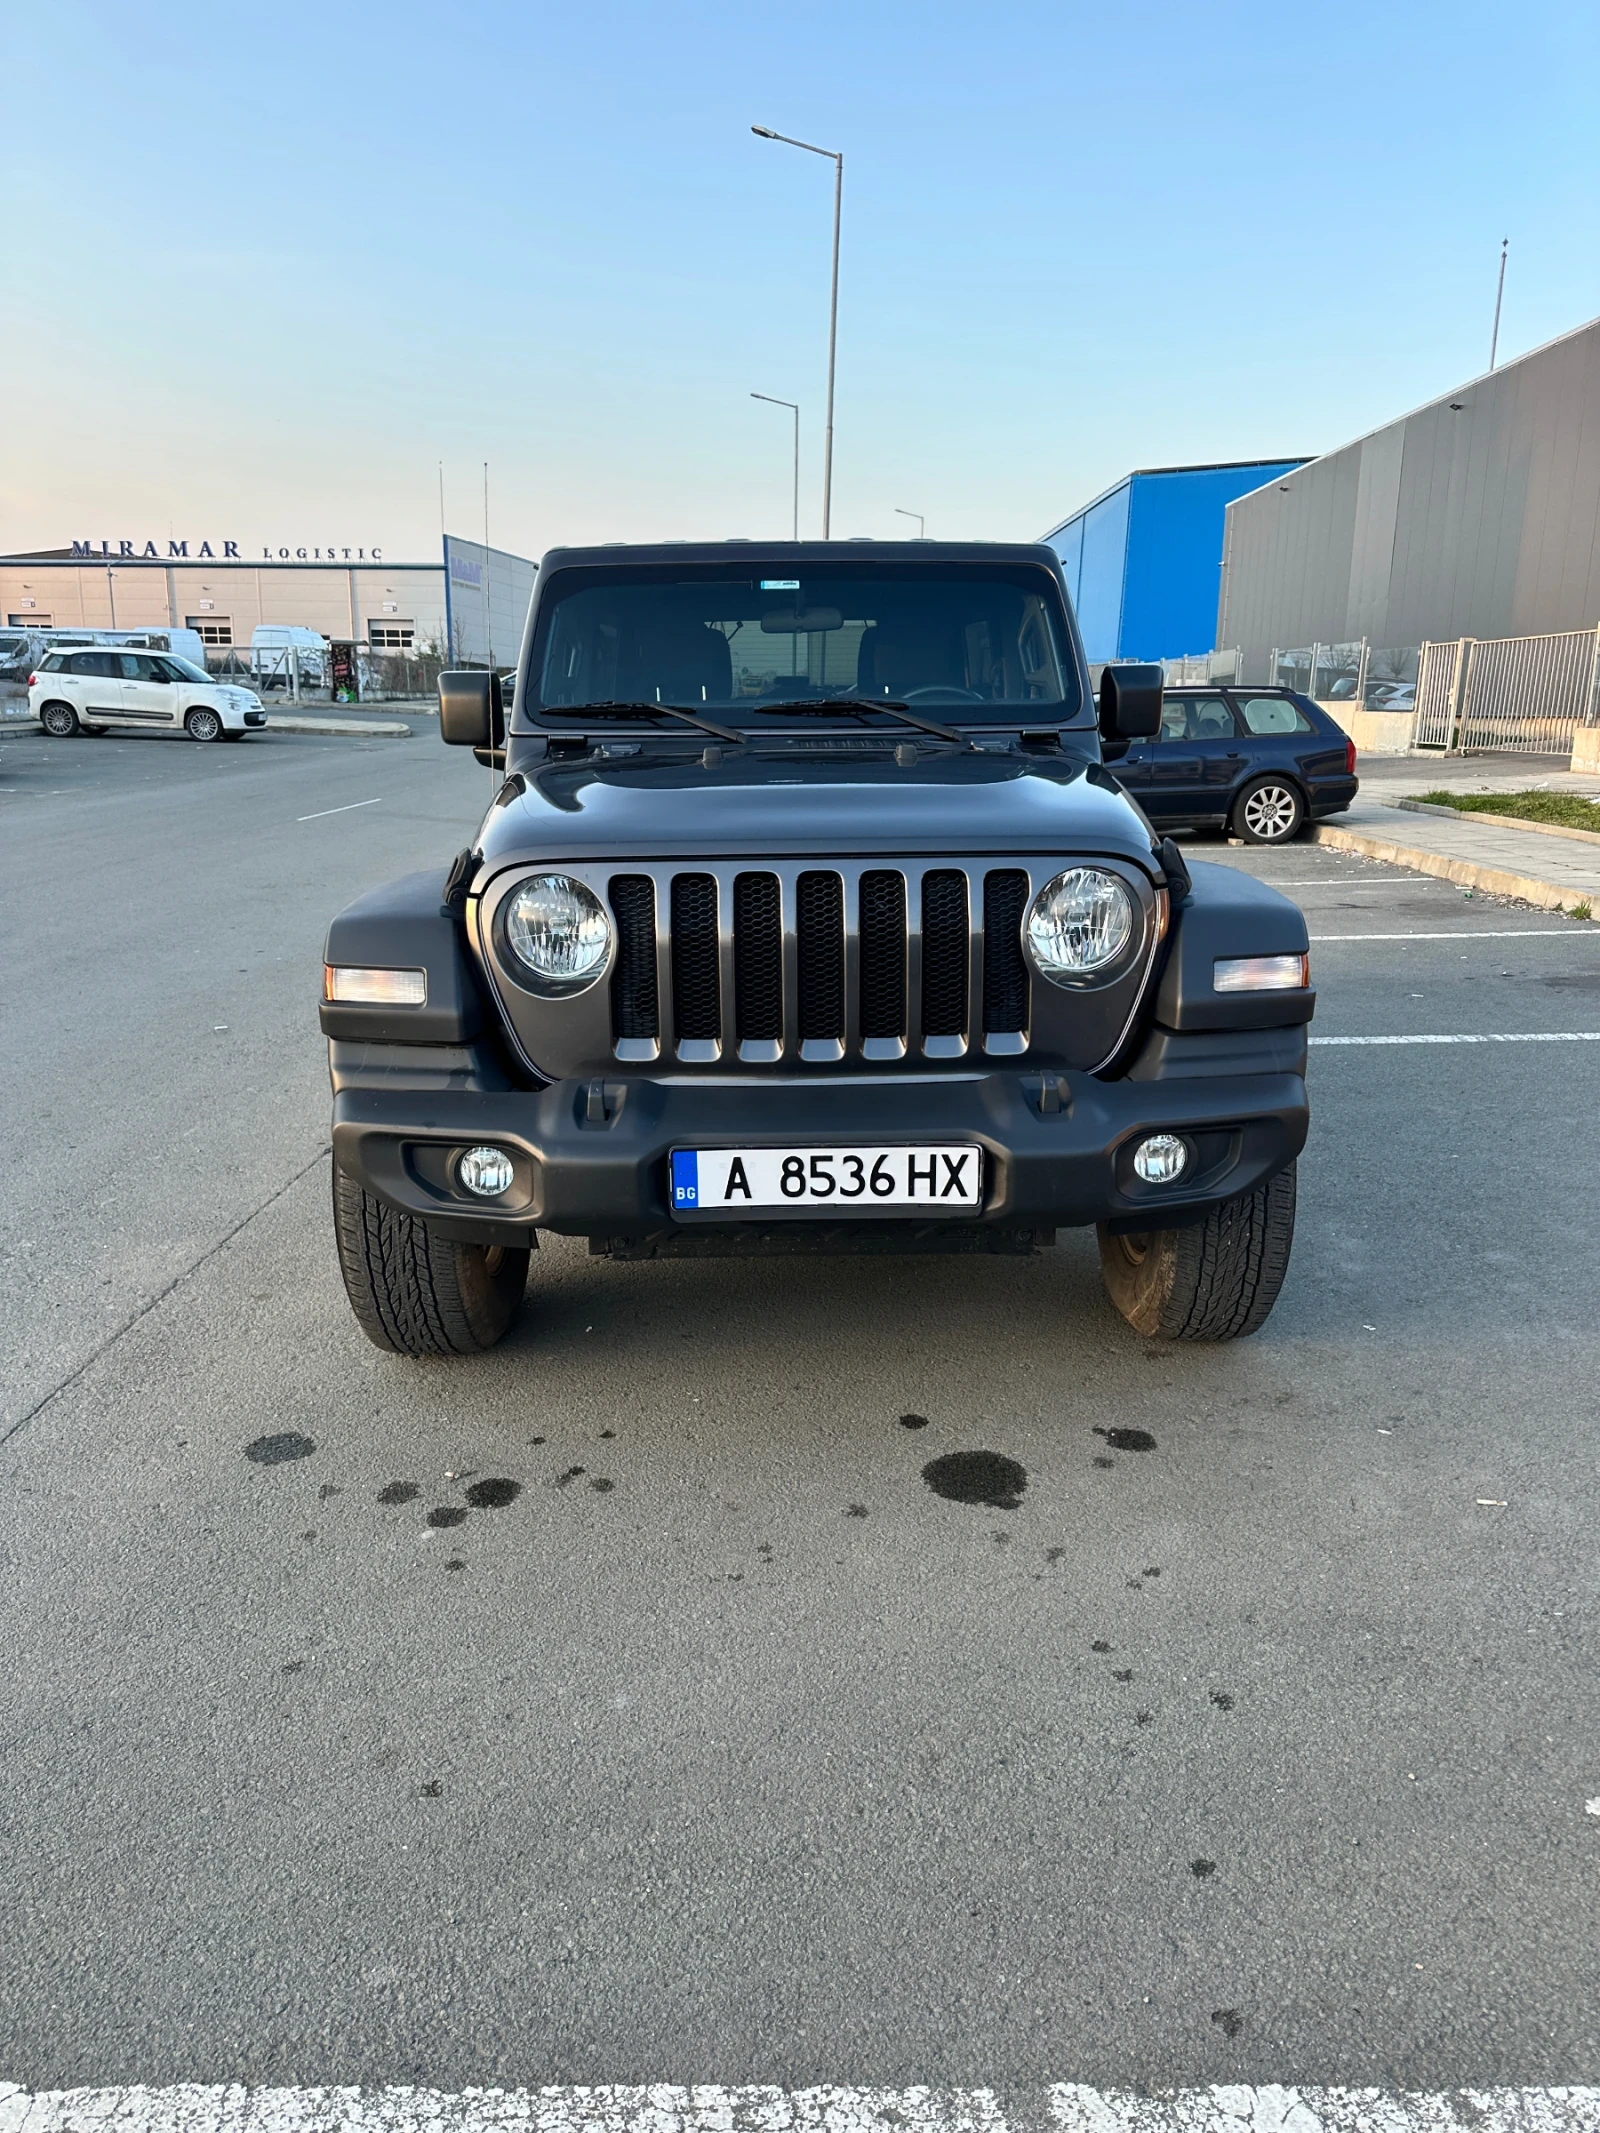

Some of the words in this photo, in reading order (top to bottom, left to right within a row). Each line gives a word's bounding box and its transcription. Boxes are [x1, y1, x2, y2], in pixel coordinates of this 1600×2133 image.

[70, 540, 241, 558] MIRAMAR
[263, 547, 383, 559] LOGISTIC
[724, 1157, 752, 1199] A
[780, 1154, 895, 1198] 8536
[908, 1154, 969, 1197] HX
[676, 1187, 696, 1200] BG
